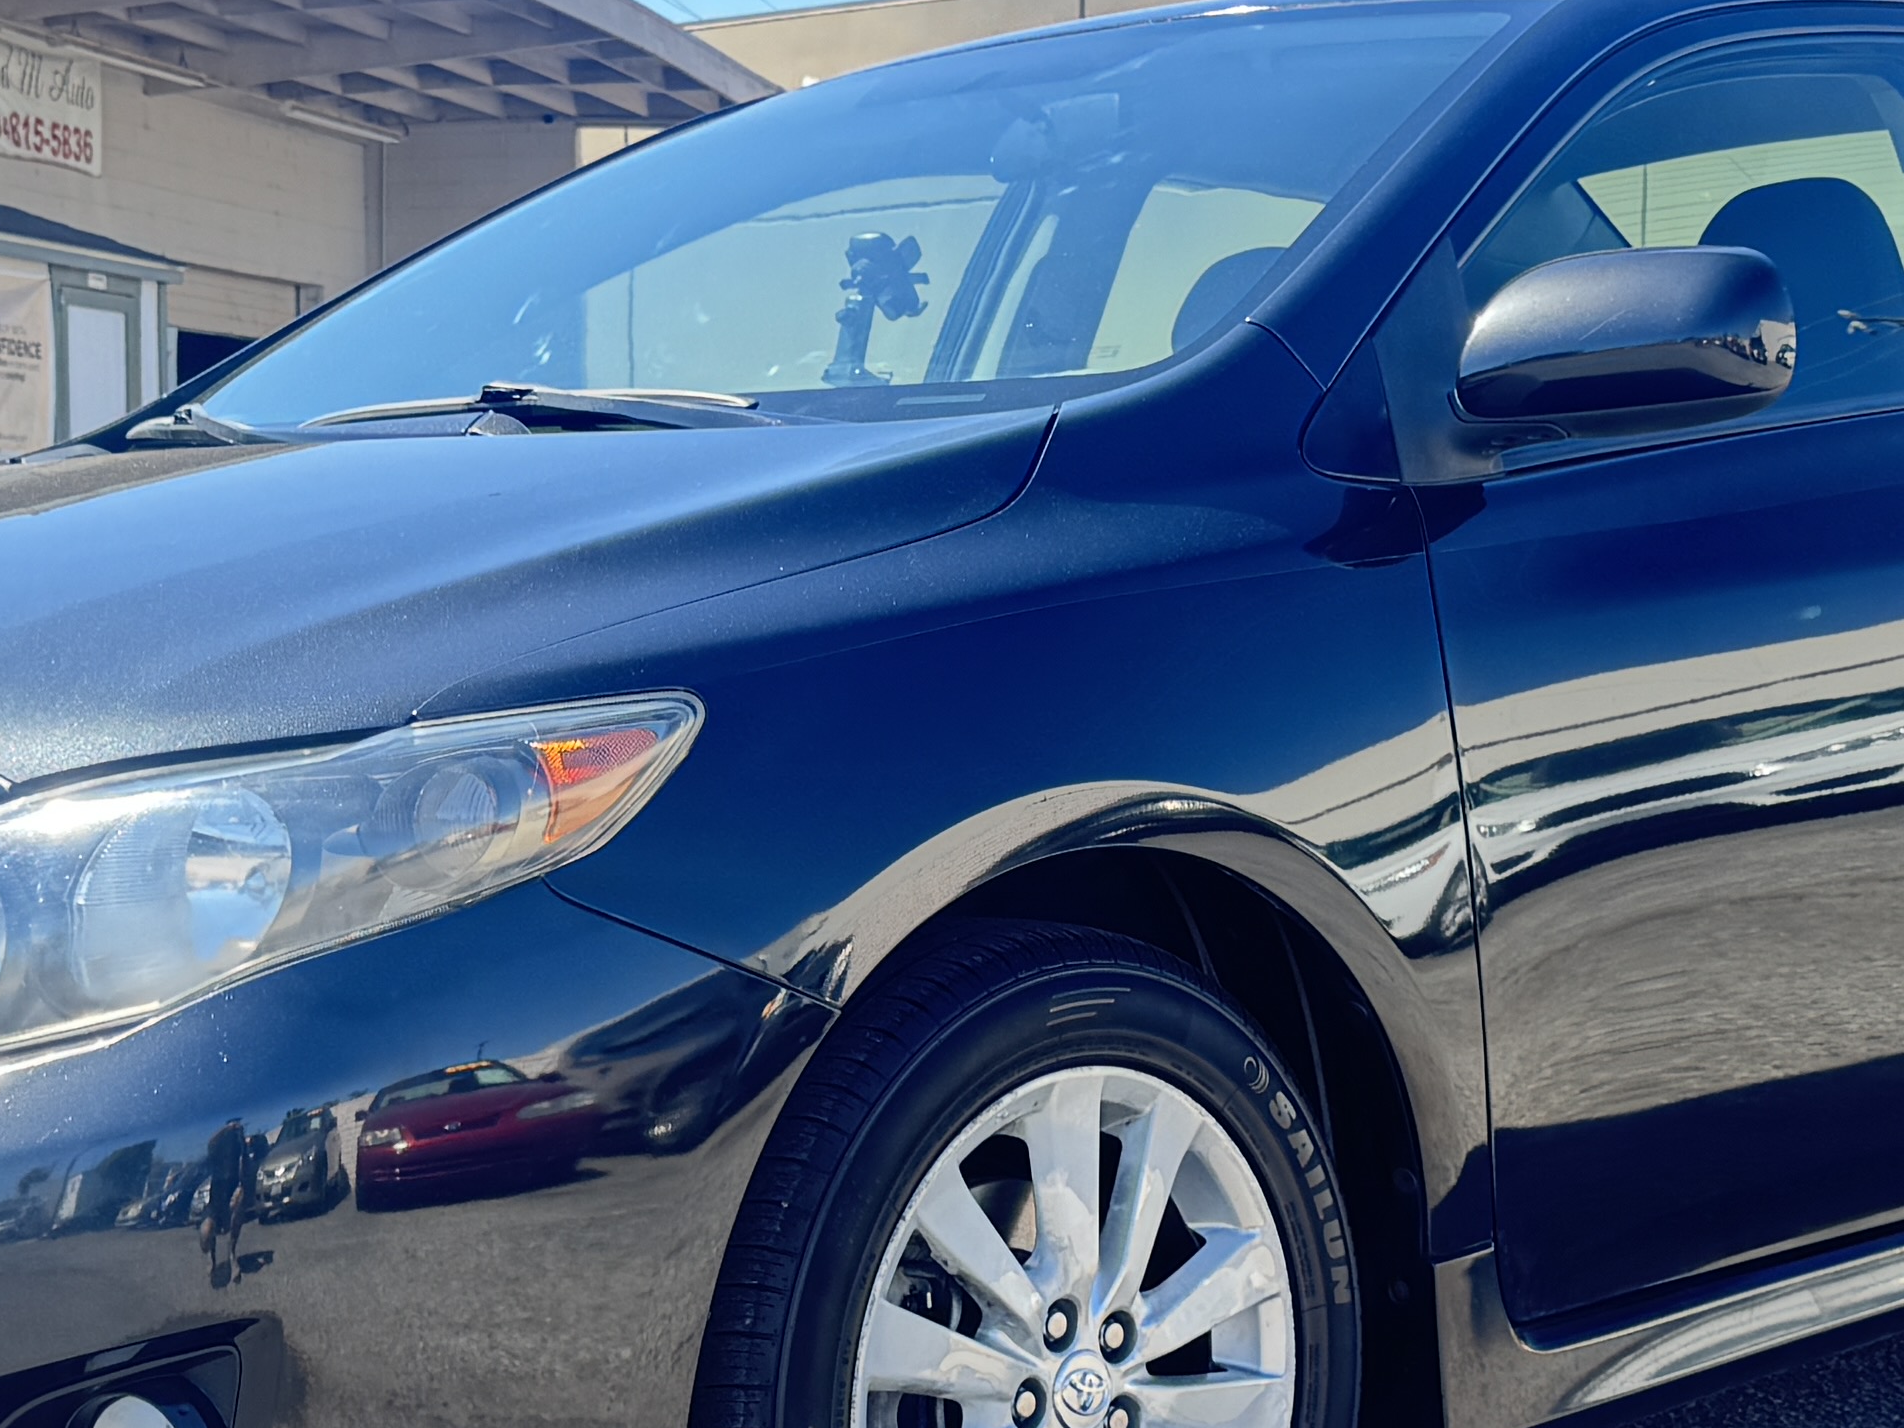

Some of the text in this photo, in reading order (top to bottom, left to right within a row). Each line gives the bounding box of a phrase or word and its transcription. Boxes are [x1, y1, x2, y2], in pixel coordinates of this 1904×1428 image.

[17, 46, 45, 99] M
[48, 58, 95, 111] Auto
[1272, 1088, 1351, 1306] SAILUN
